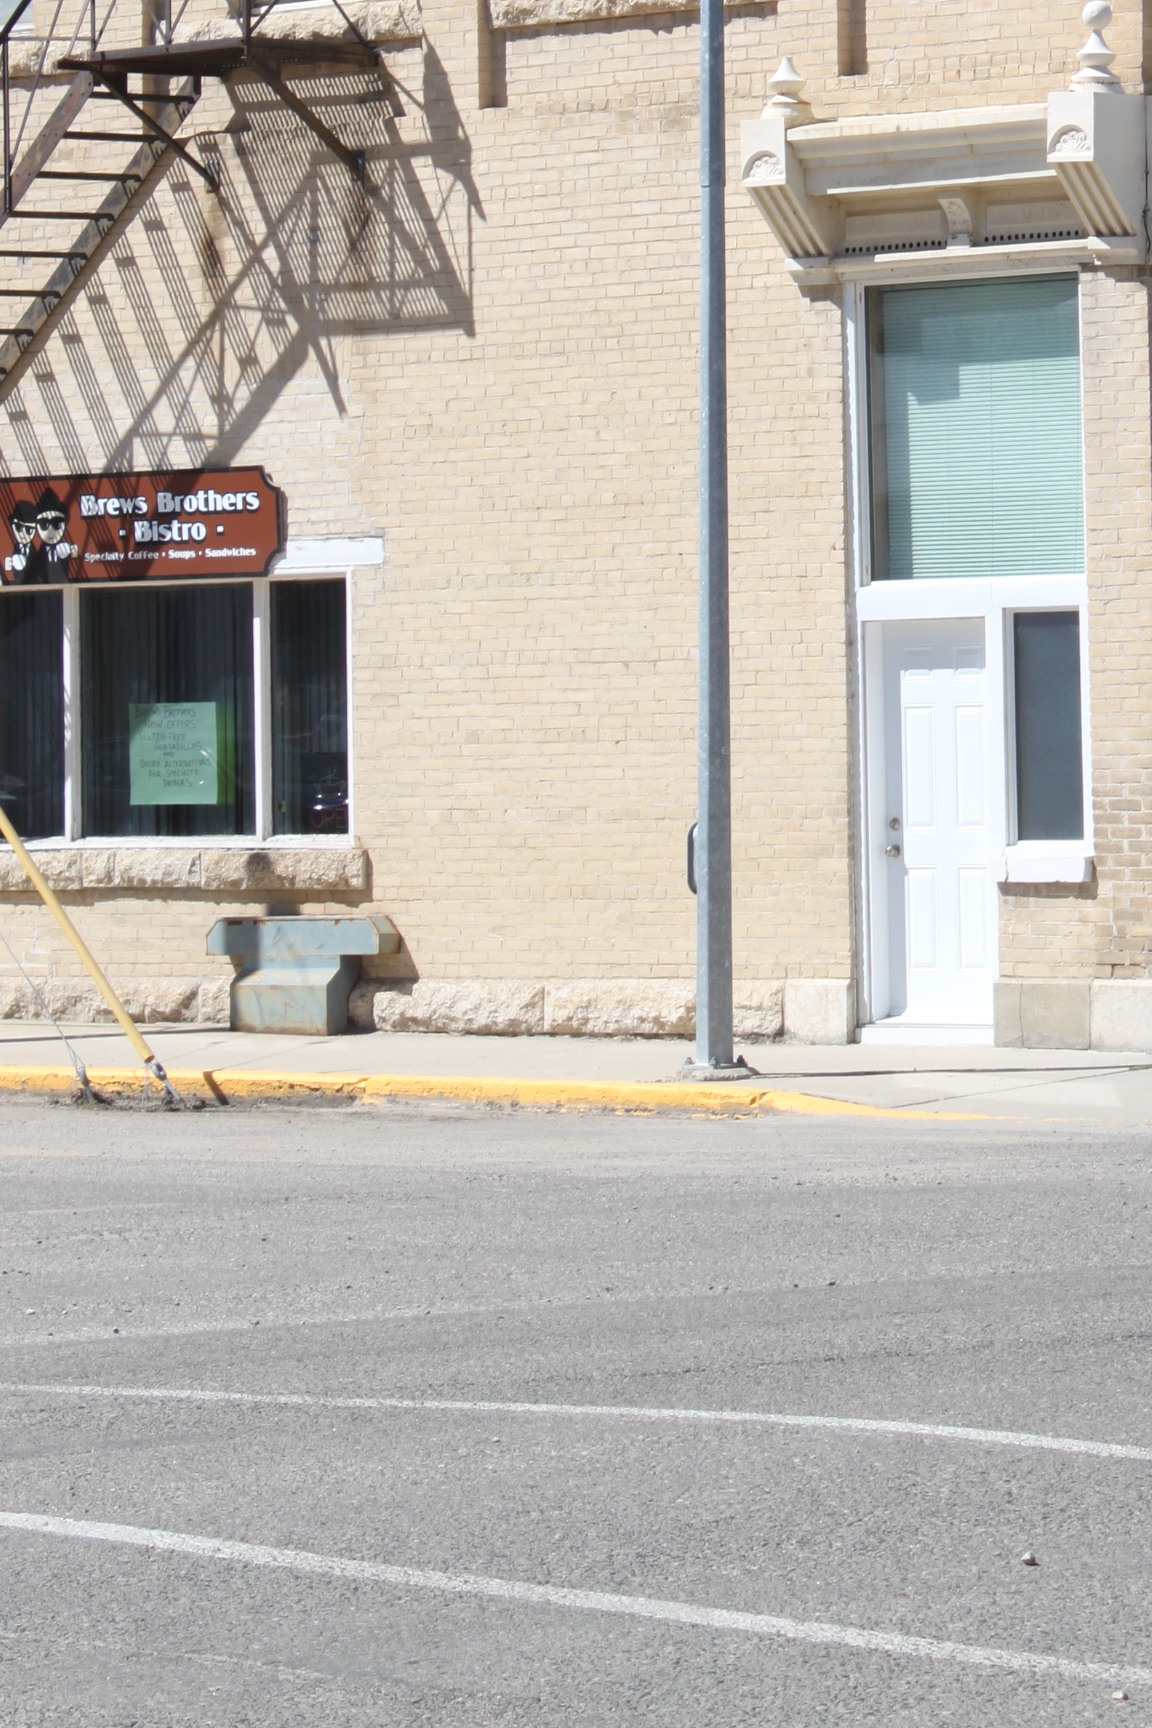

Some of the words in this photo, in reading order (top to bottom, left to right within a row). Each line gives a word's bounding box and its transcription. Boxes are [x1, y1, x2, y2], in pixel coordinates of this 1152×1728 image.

[80, 494, 148, 517] Brews
[157, 489, 260, 514] Brothers
[134, 519, 207, 542] Bistro
[84, 551, 124, 563] Specialty
[128, 550, 159, 560] Coffee
[168, 548, 196, 560] Soups
[205, 547, 256, 558] Sandwiches
